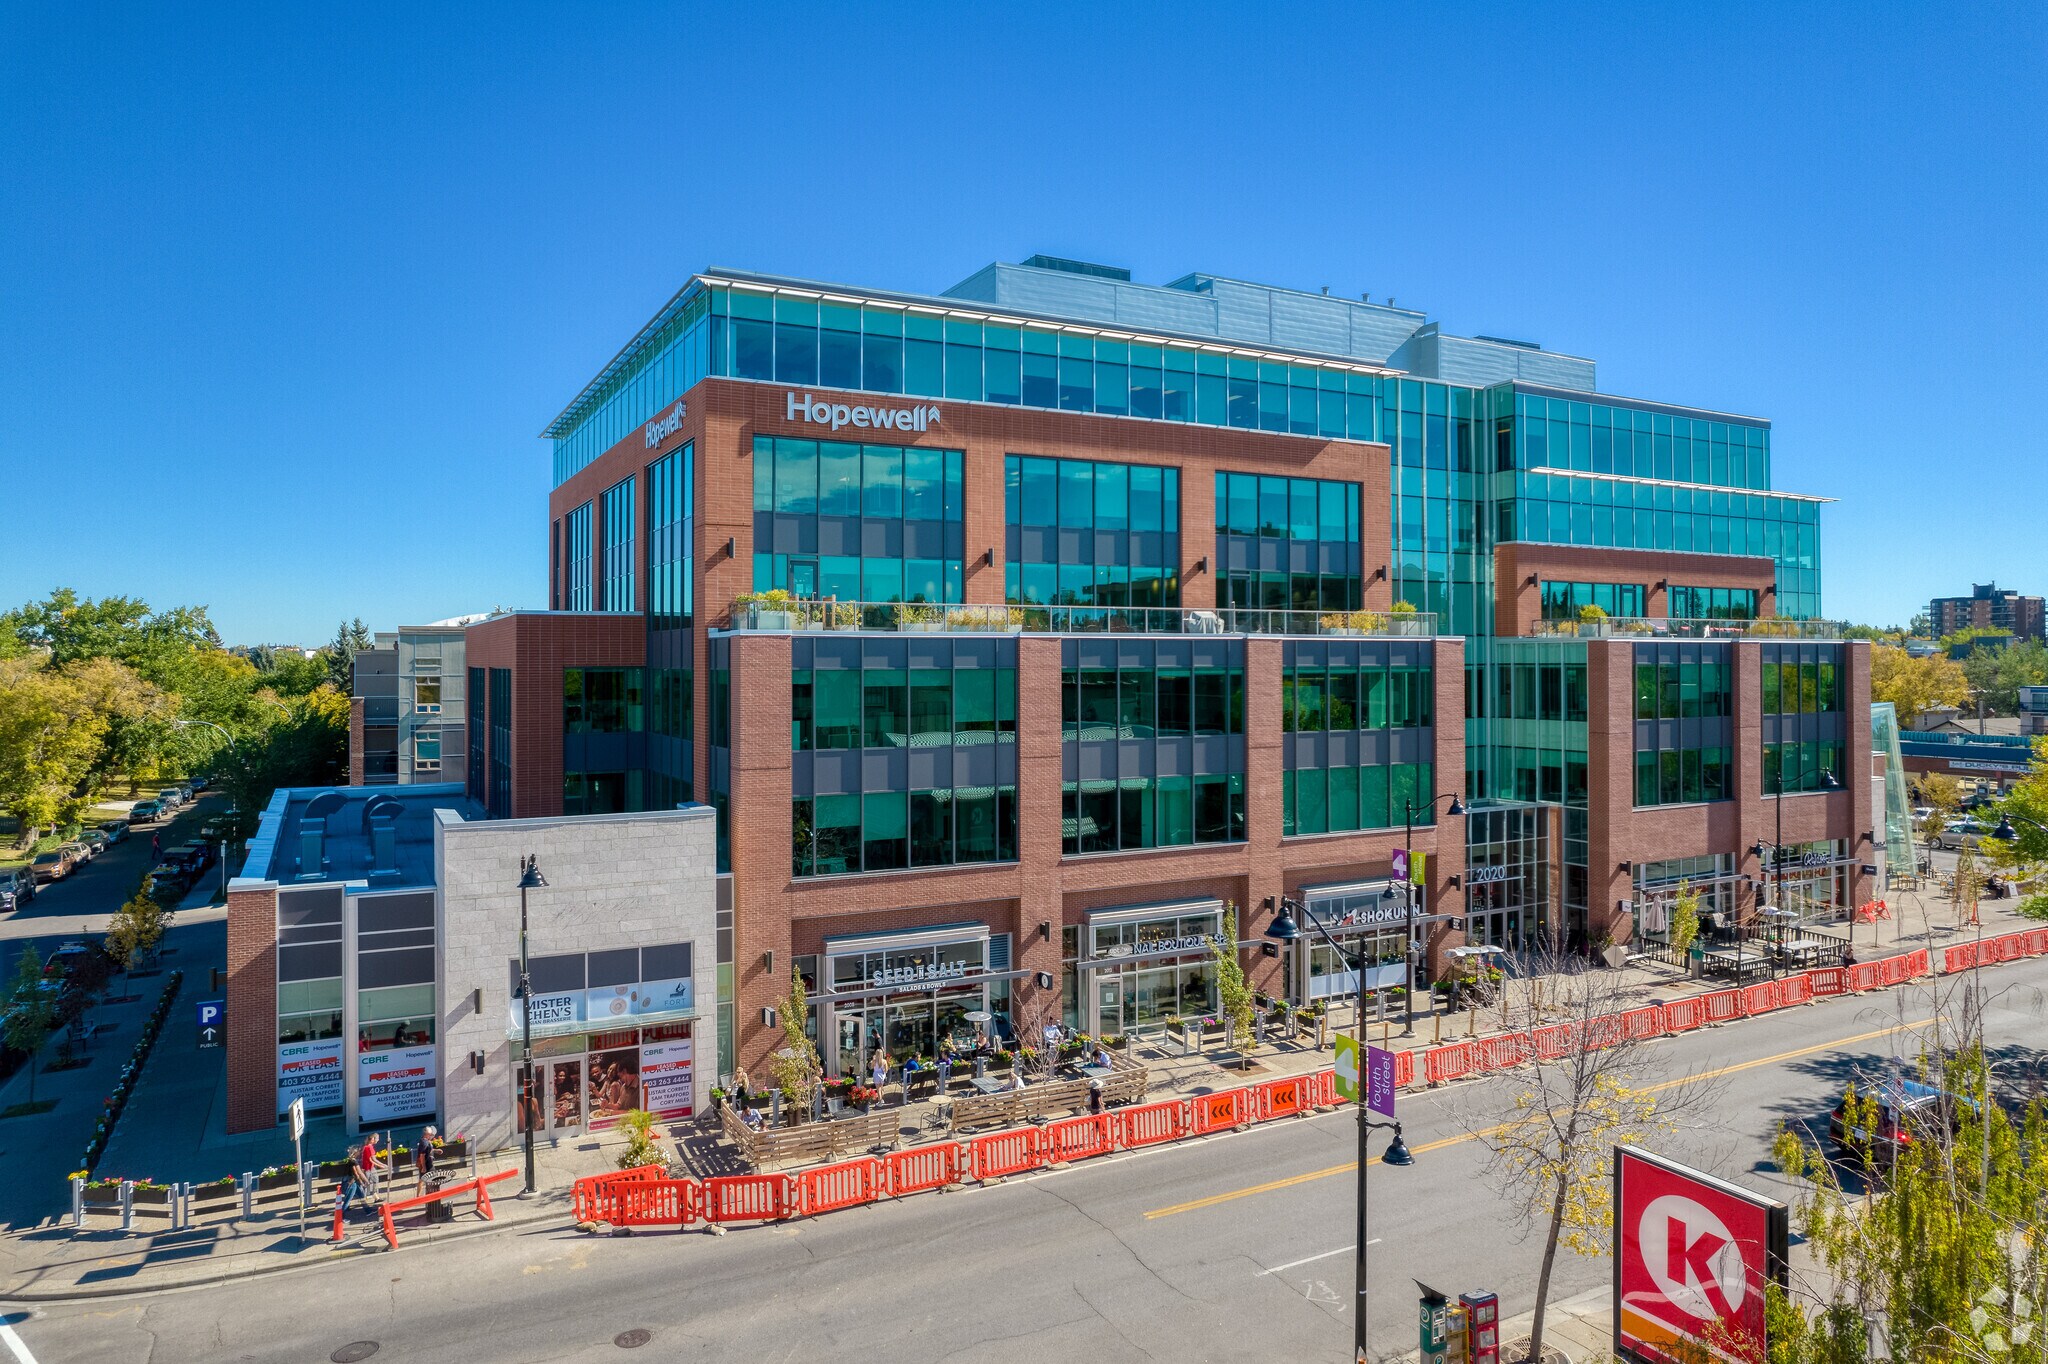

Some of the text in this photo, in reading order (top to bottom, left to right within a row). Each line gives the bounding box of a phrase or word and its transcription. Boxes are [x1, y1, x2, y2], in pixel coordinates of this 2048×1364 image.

[787, 392, 927, 431] Hopewell
[646, 402, 682, 449] Hopewell
[1477, 866, 1505, 881] 2020
[1360, 904, 1420, 923] SHOKUNN
[872, 966, 914, 986] SEED
[927, 960, 966, 979] SALT
[528, 997, 571, 1010] MISTER
[664, 998, 687, 1006] FORT
[202, 1006, 217, 1023] P
[282, 1046, 309, 1056] CBRE
[361, 1055, 388, 1065] CBRE
[1335, 1048, 1358, 1092] 4
[1382, 1056, 1390, 1095] street
[282, 1073, 340, 1086] 403 263 4444
[1373, 1067, 1381, 1107] fourth
[290, 1086, 314, 1094] ALISTAIR
[311, 1089, 340, 1097] TRAFFORD
[369, 1081, 426, 1094] 403 263 4444
[399, 1097, 426, 1106] TRAFFORD
[1668, 1216, 1736, 1322] K
